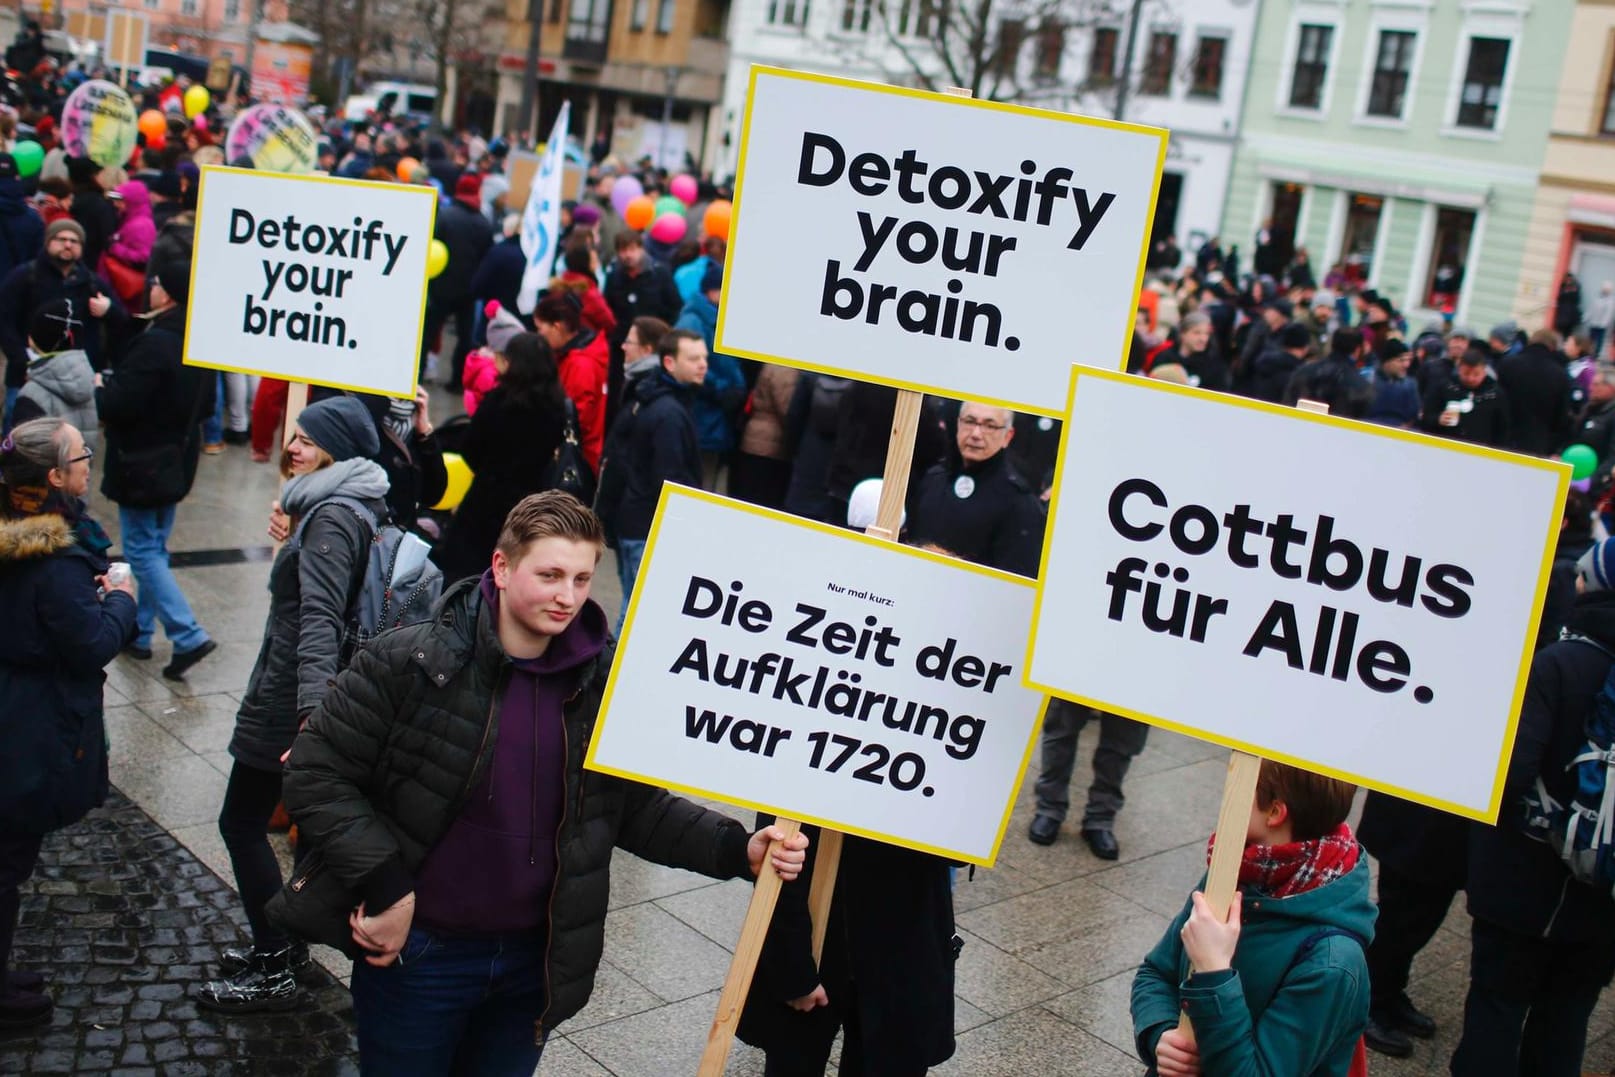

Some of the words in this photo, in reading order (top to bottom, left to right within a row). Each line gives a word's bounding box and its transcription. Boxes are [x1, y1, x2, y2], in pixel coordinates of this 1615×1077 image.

[797, 131, 1117, 251] Detoxify
[228, 208, 409, 276] Detoxify
[261, 259, 353, 301] your
[852, 210, 1018, 278] your
[243, 294, 357, 350] brain.
[820, 258, 1021, 352] brain.
[827, 582, 846, 594] Nur
[847, 587, 867, 600] mal
[869, 591, 895, 607] kurz:
[1108, 478, 1475, 619] Cottbus
[681, 575, 773, 634] Die
[785, 602, 901, 668] Zeit
[915, 637, 1013, 694] der
[1105, 557, 1229, 644] für
[1242, 599, 1434, 704] Alle.
[668, 637, 987, 761] Aufklärung
[685, 705, 793, 758] war
[807, 731, 935, 798] 1720.
